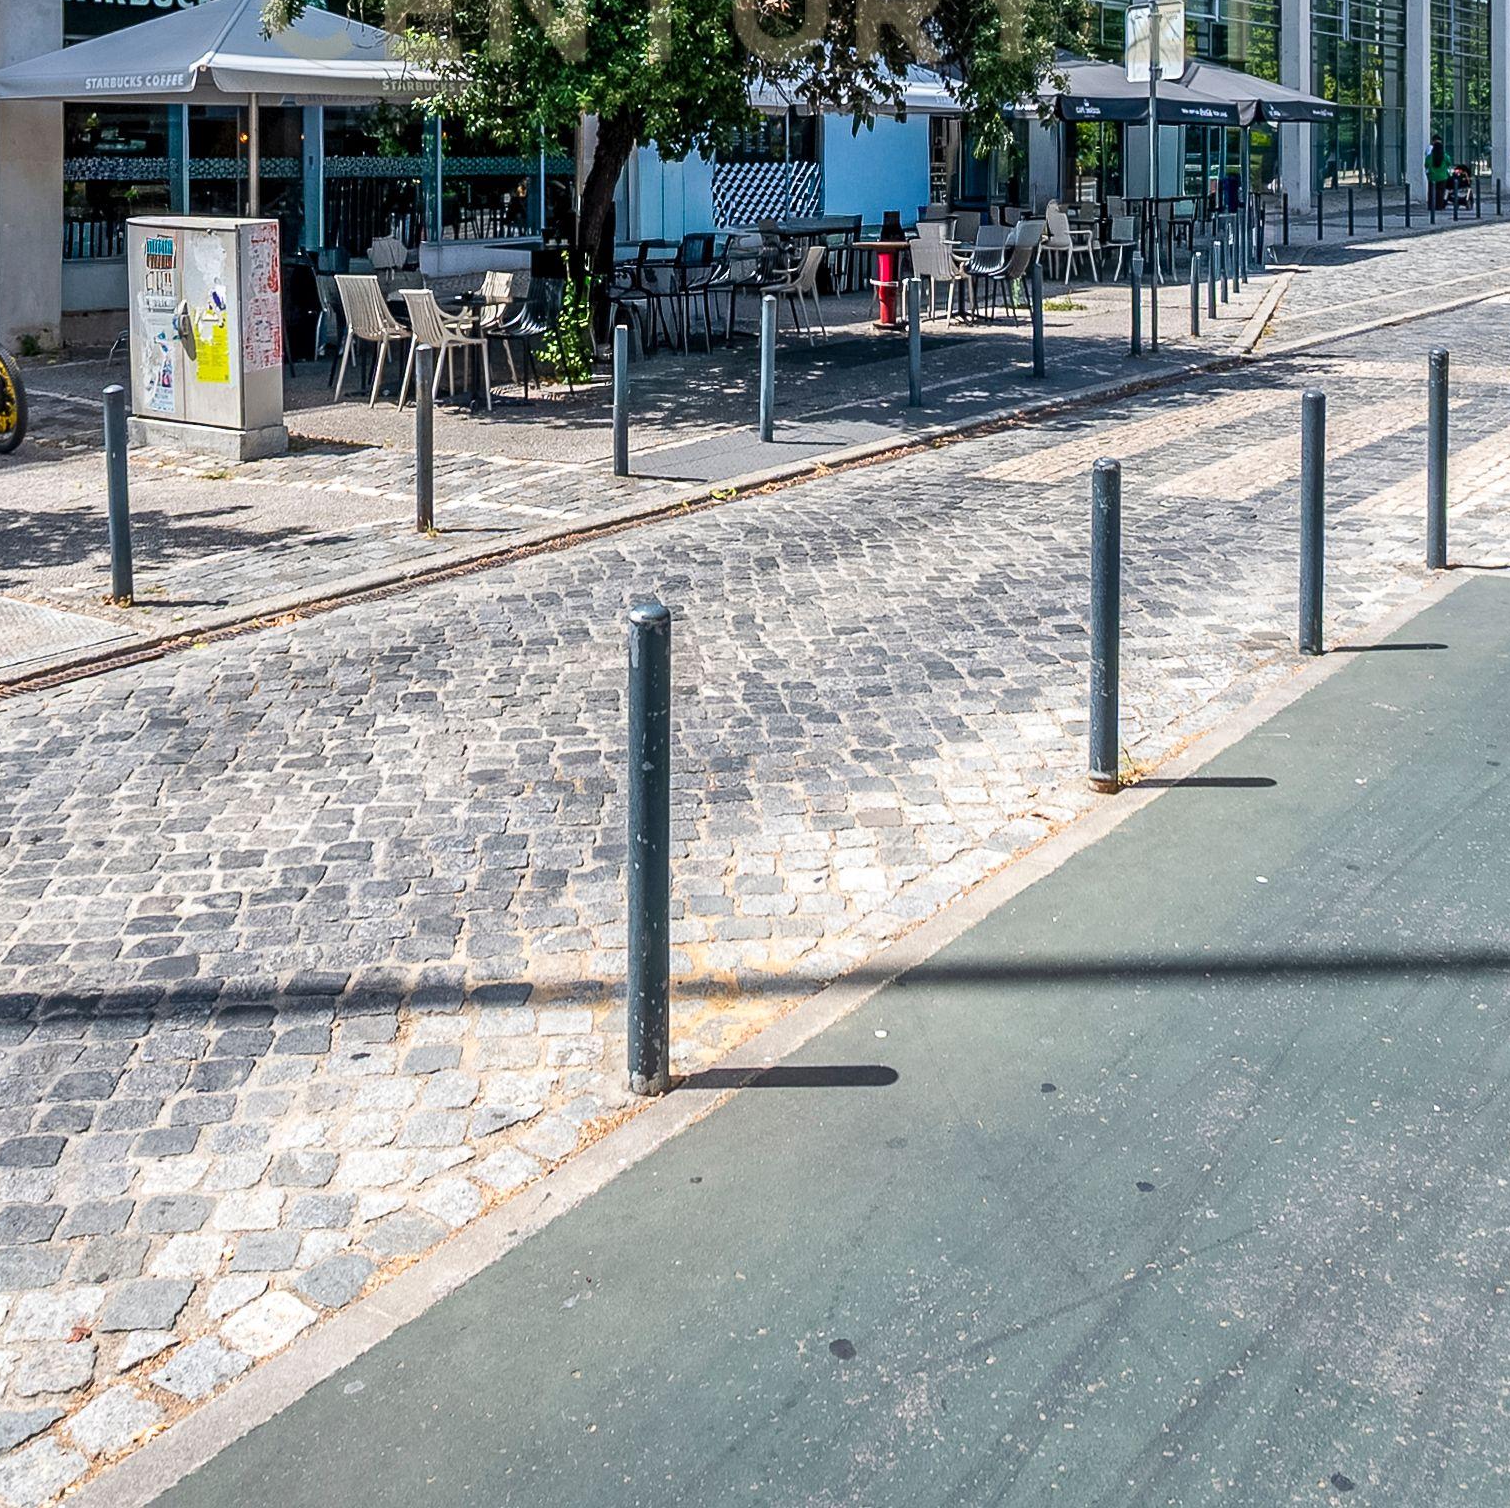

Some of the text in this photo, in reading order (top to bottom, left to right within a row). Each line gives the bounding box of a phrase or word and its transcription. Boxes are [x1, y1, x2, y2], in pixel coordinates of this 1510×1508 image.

[85, 73, 184, 90] STARBUCKS COFFEE
[381, 80, 456, 92] STARBUCKS
